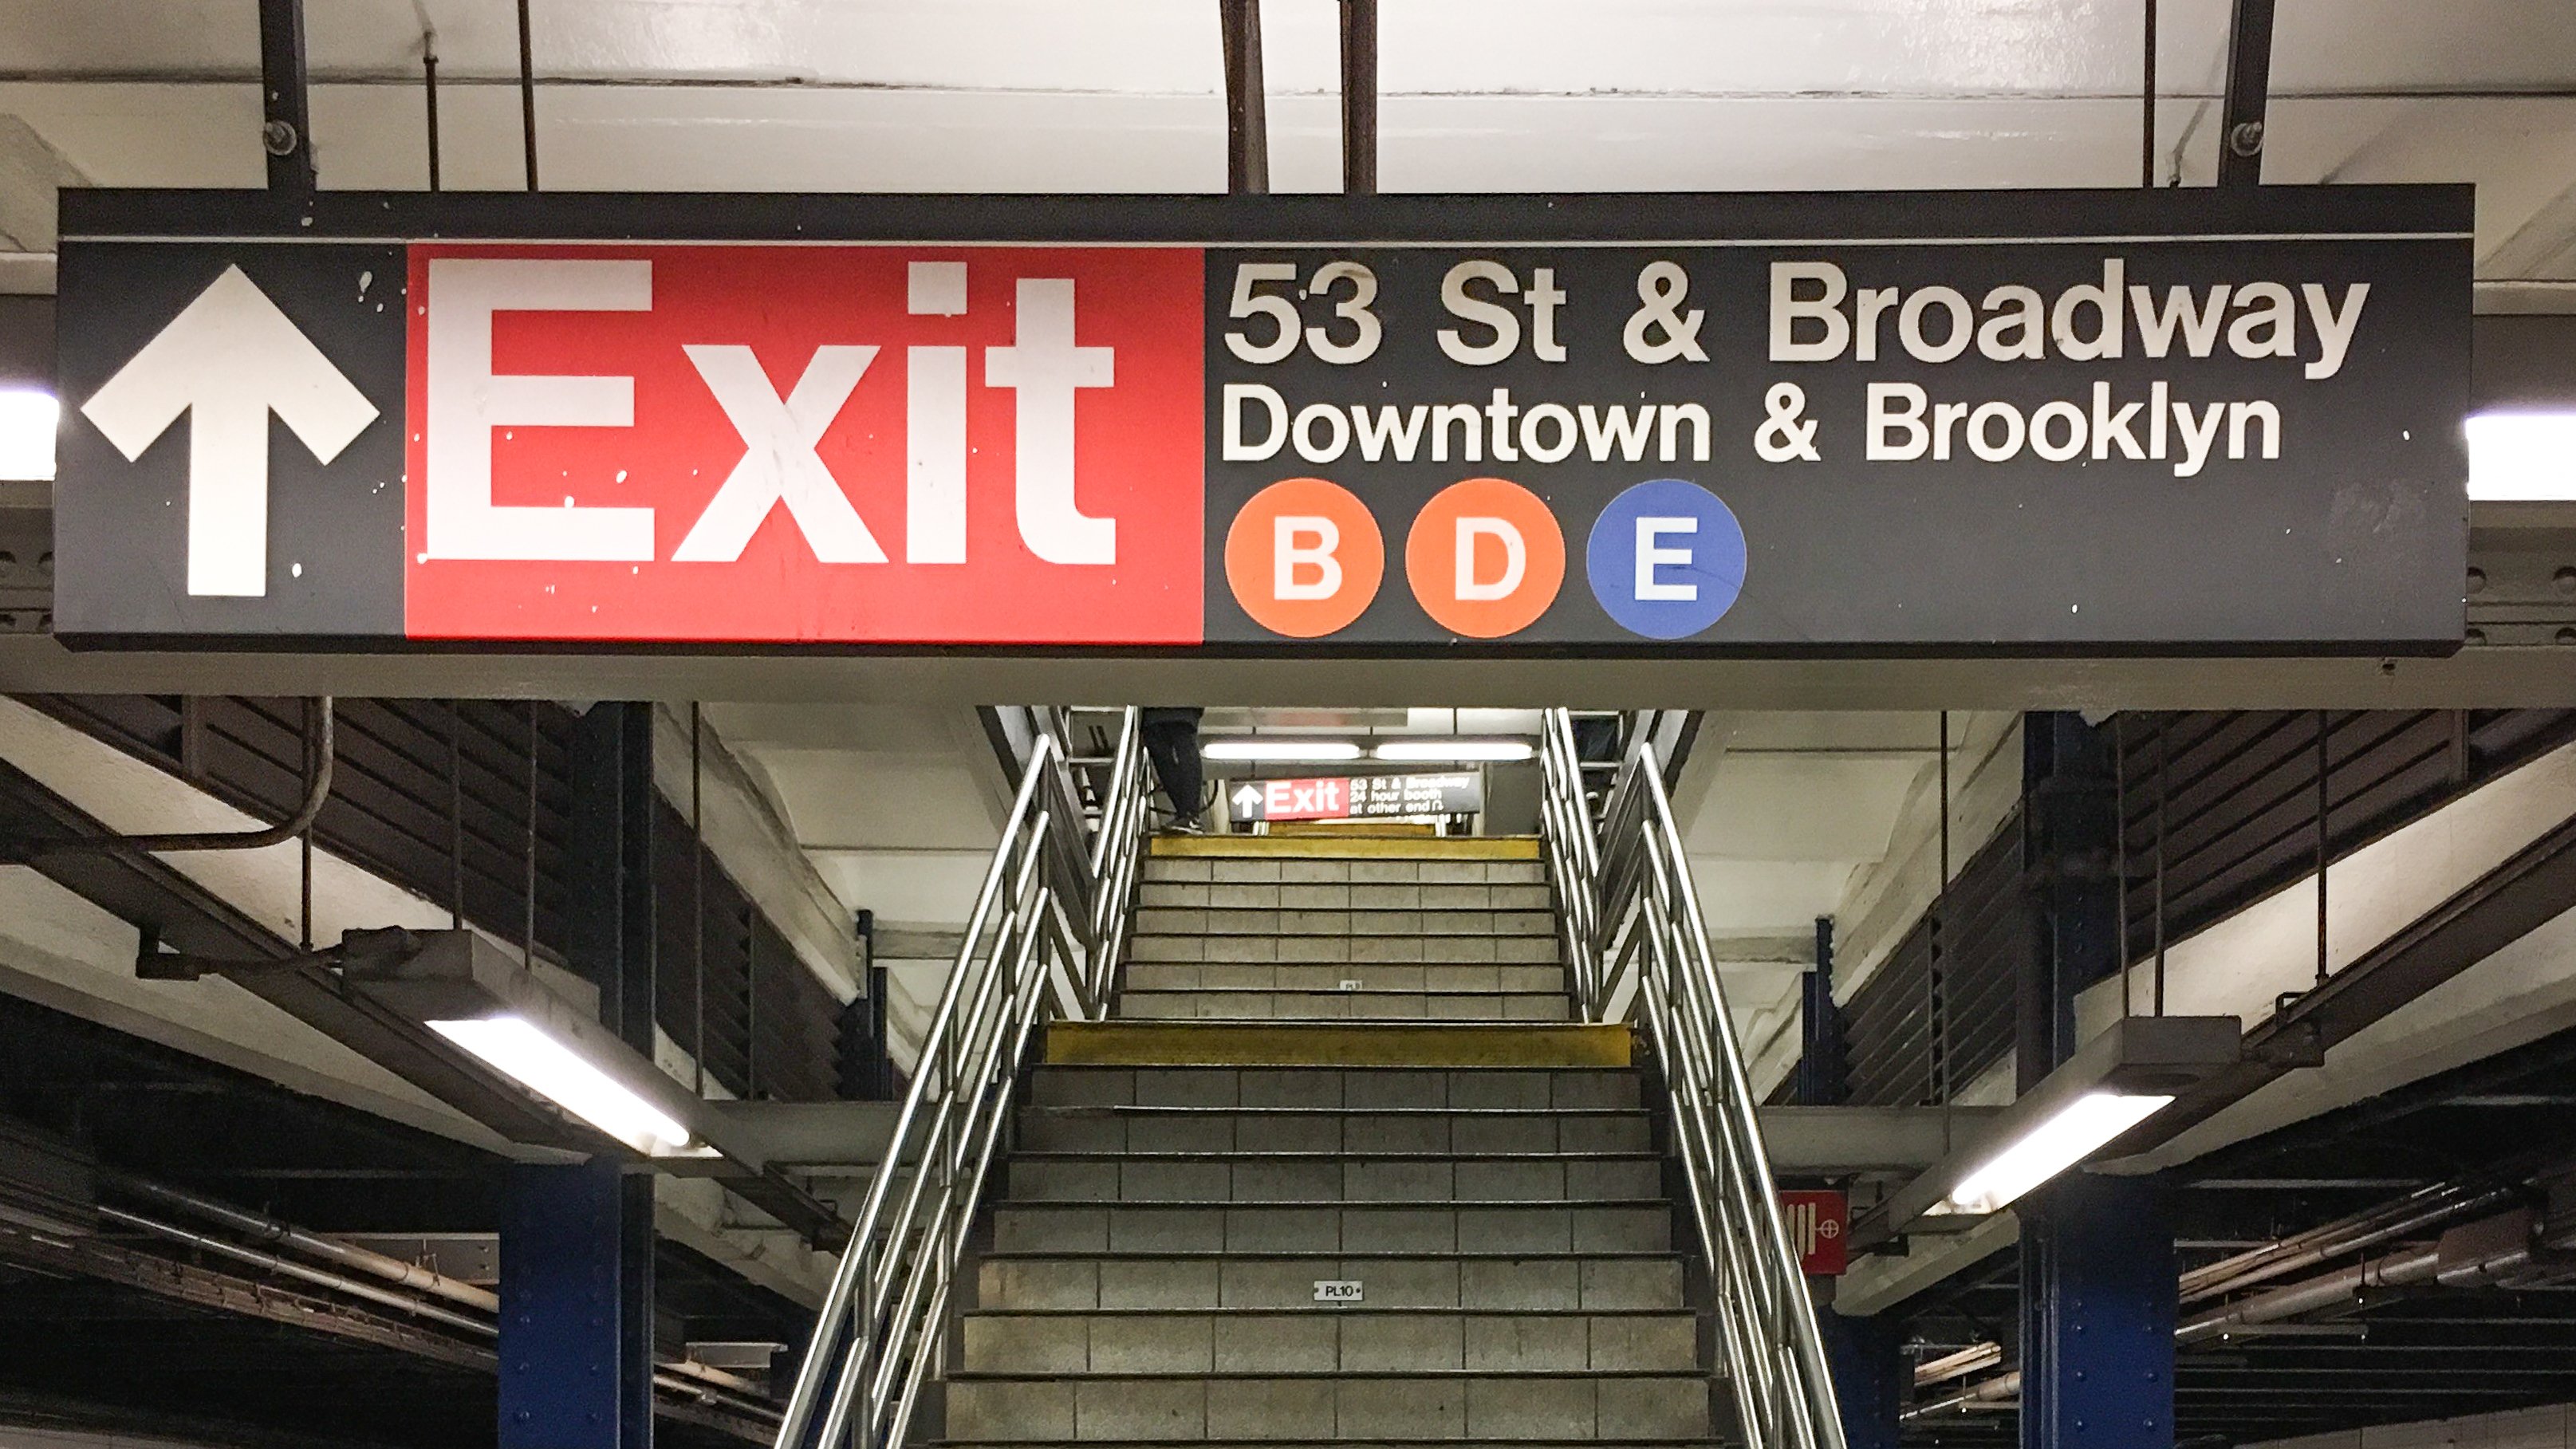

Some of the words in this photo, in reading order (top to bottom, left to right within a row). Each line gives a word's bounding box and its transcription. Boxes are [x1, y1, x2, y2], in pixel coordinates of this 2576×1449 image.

[1224, 262, 1382, 364] 53
[1436, 262, 1566, 366] St
[1623, 261, 1711, 364] &
[1769, 258, 2370, 380] Broadway
[427, 258, 1117, 565] Exit
[1223, 383, 1711, 463] Downtown
[1754, 381, 1822, 463] &
[1865, 380, 2281, 478] Brooklyn
[1273, 514, 1343, 601] B
[1454, 515, 1527, 602] D
[1634, 515, 1699, 601] E
[1266, 781, 1340, 814] Exit
[1349, 790, 1367, 803] 24
[1371, 789, 1400, 802] hour
[1404, 788, 1443, 801] booth
[1372, 777, 1387, 790] St
[1391, 776, 1401, 789] &
[1406, 776, 1470, 789] Broadway
[1349, 804, 1363, 814] at
[1367, 801, 1401, 813] other
[1405, 800, 1430, 813] end
[1325, 1286, 1354, 1297] PL10
